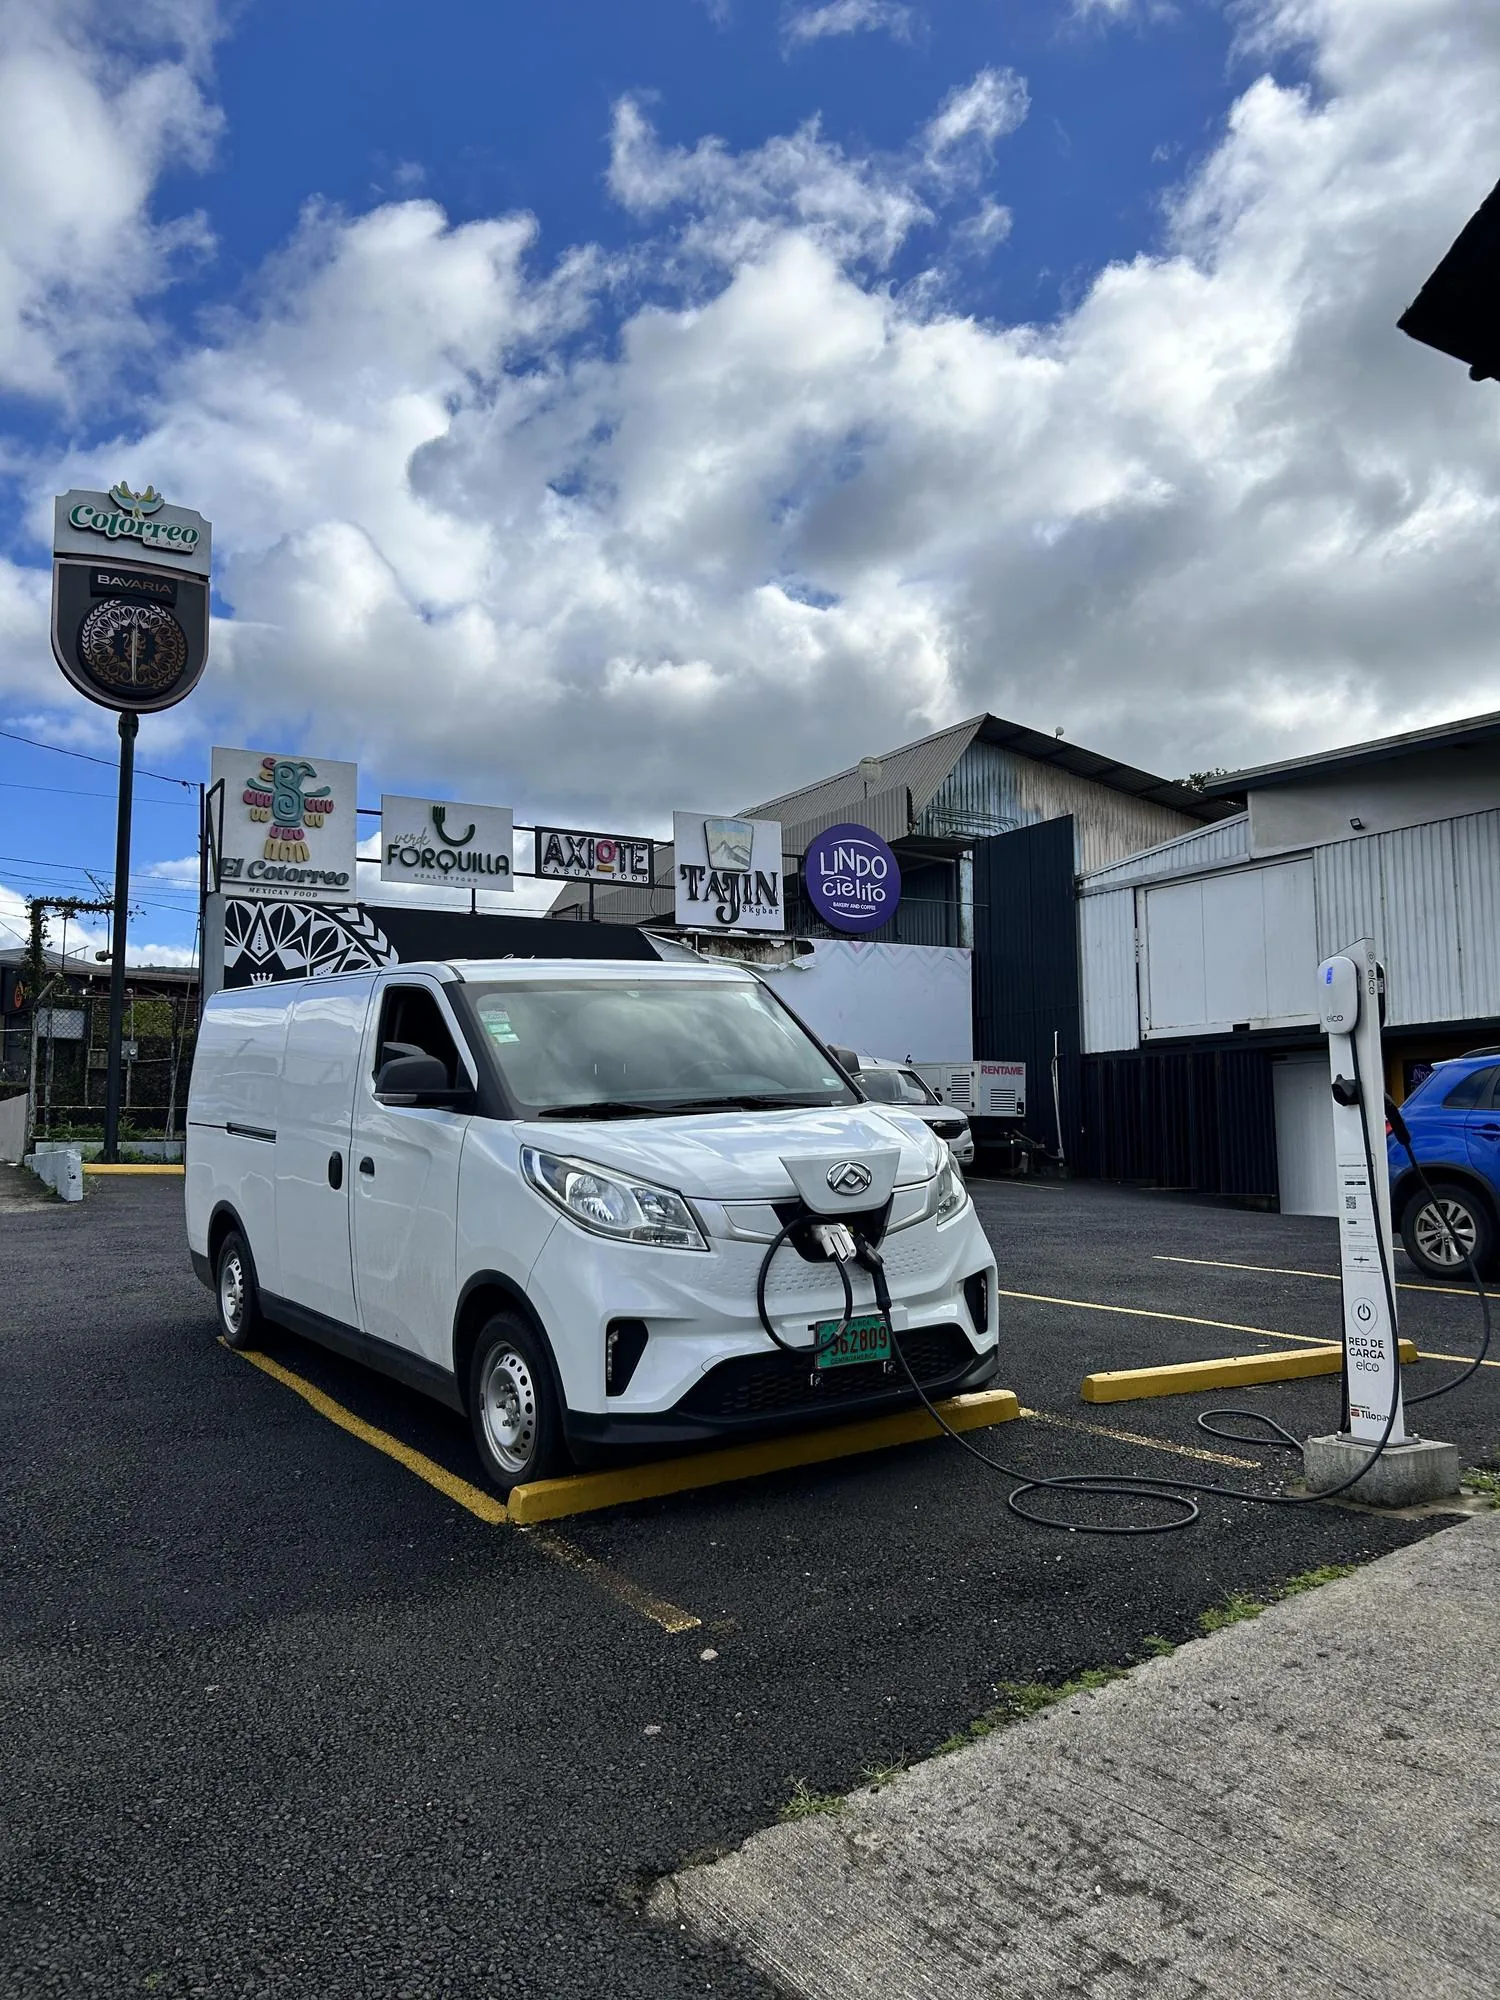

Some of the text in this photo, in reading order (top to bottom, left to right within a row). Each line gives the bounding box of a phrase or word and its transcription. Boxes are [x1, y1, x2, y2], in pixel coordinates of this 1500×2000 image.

[71, 504, 199, 543] Cotorreo
[145, 537, 194, 550] PLAZA
[97, 574, 172, 594] BAVARIA
[387, 844, 509, 875] FORQUILLA
[543, 834, 648, 875] AXIOTE
[820, 846, 887, 879] LINDO
[219, 857, 350, 885] El Cotorreo
[611, 873, 648, 882] FOOD
[248, 887, 290, 896] MEXICAN
[680, 864, 780, 924] TAJIN
[822, 879, 887, 902] cielito
[981, 1065, 1024, 1075] RENTAME
[1348, 1337, 1384, 1348] RED DE
[1349, 1348, 1385, 1360] CARGA
[1356, 1360, 1380, 1372] elco
